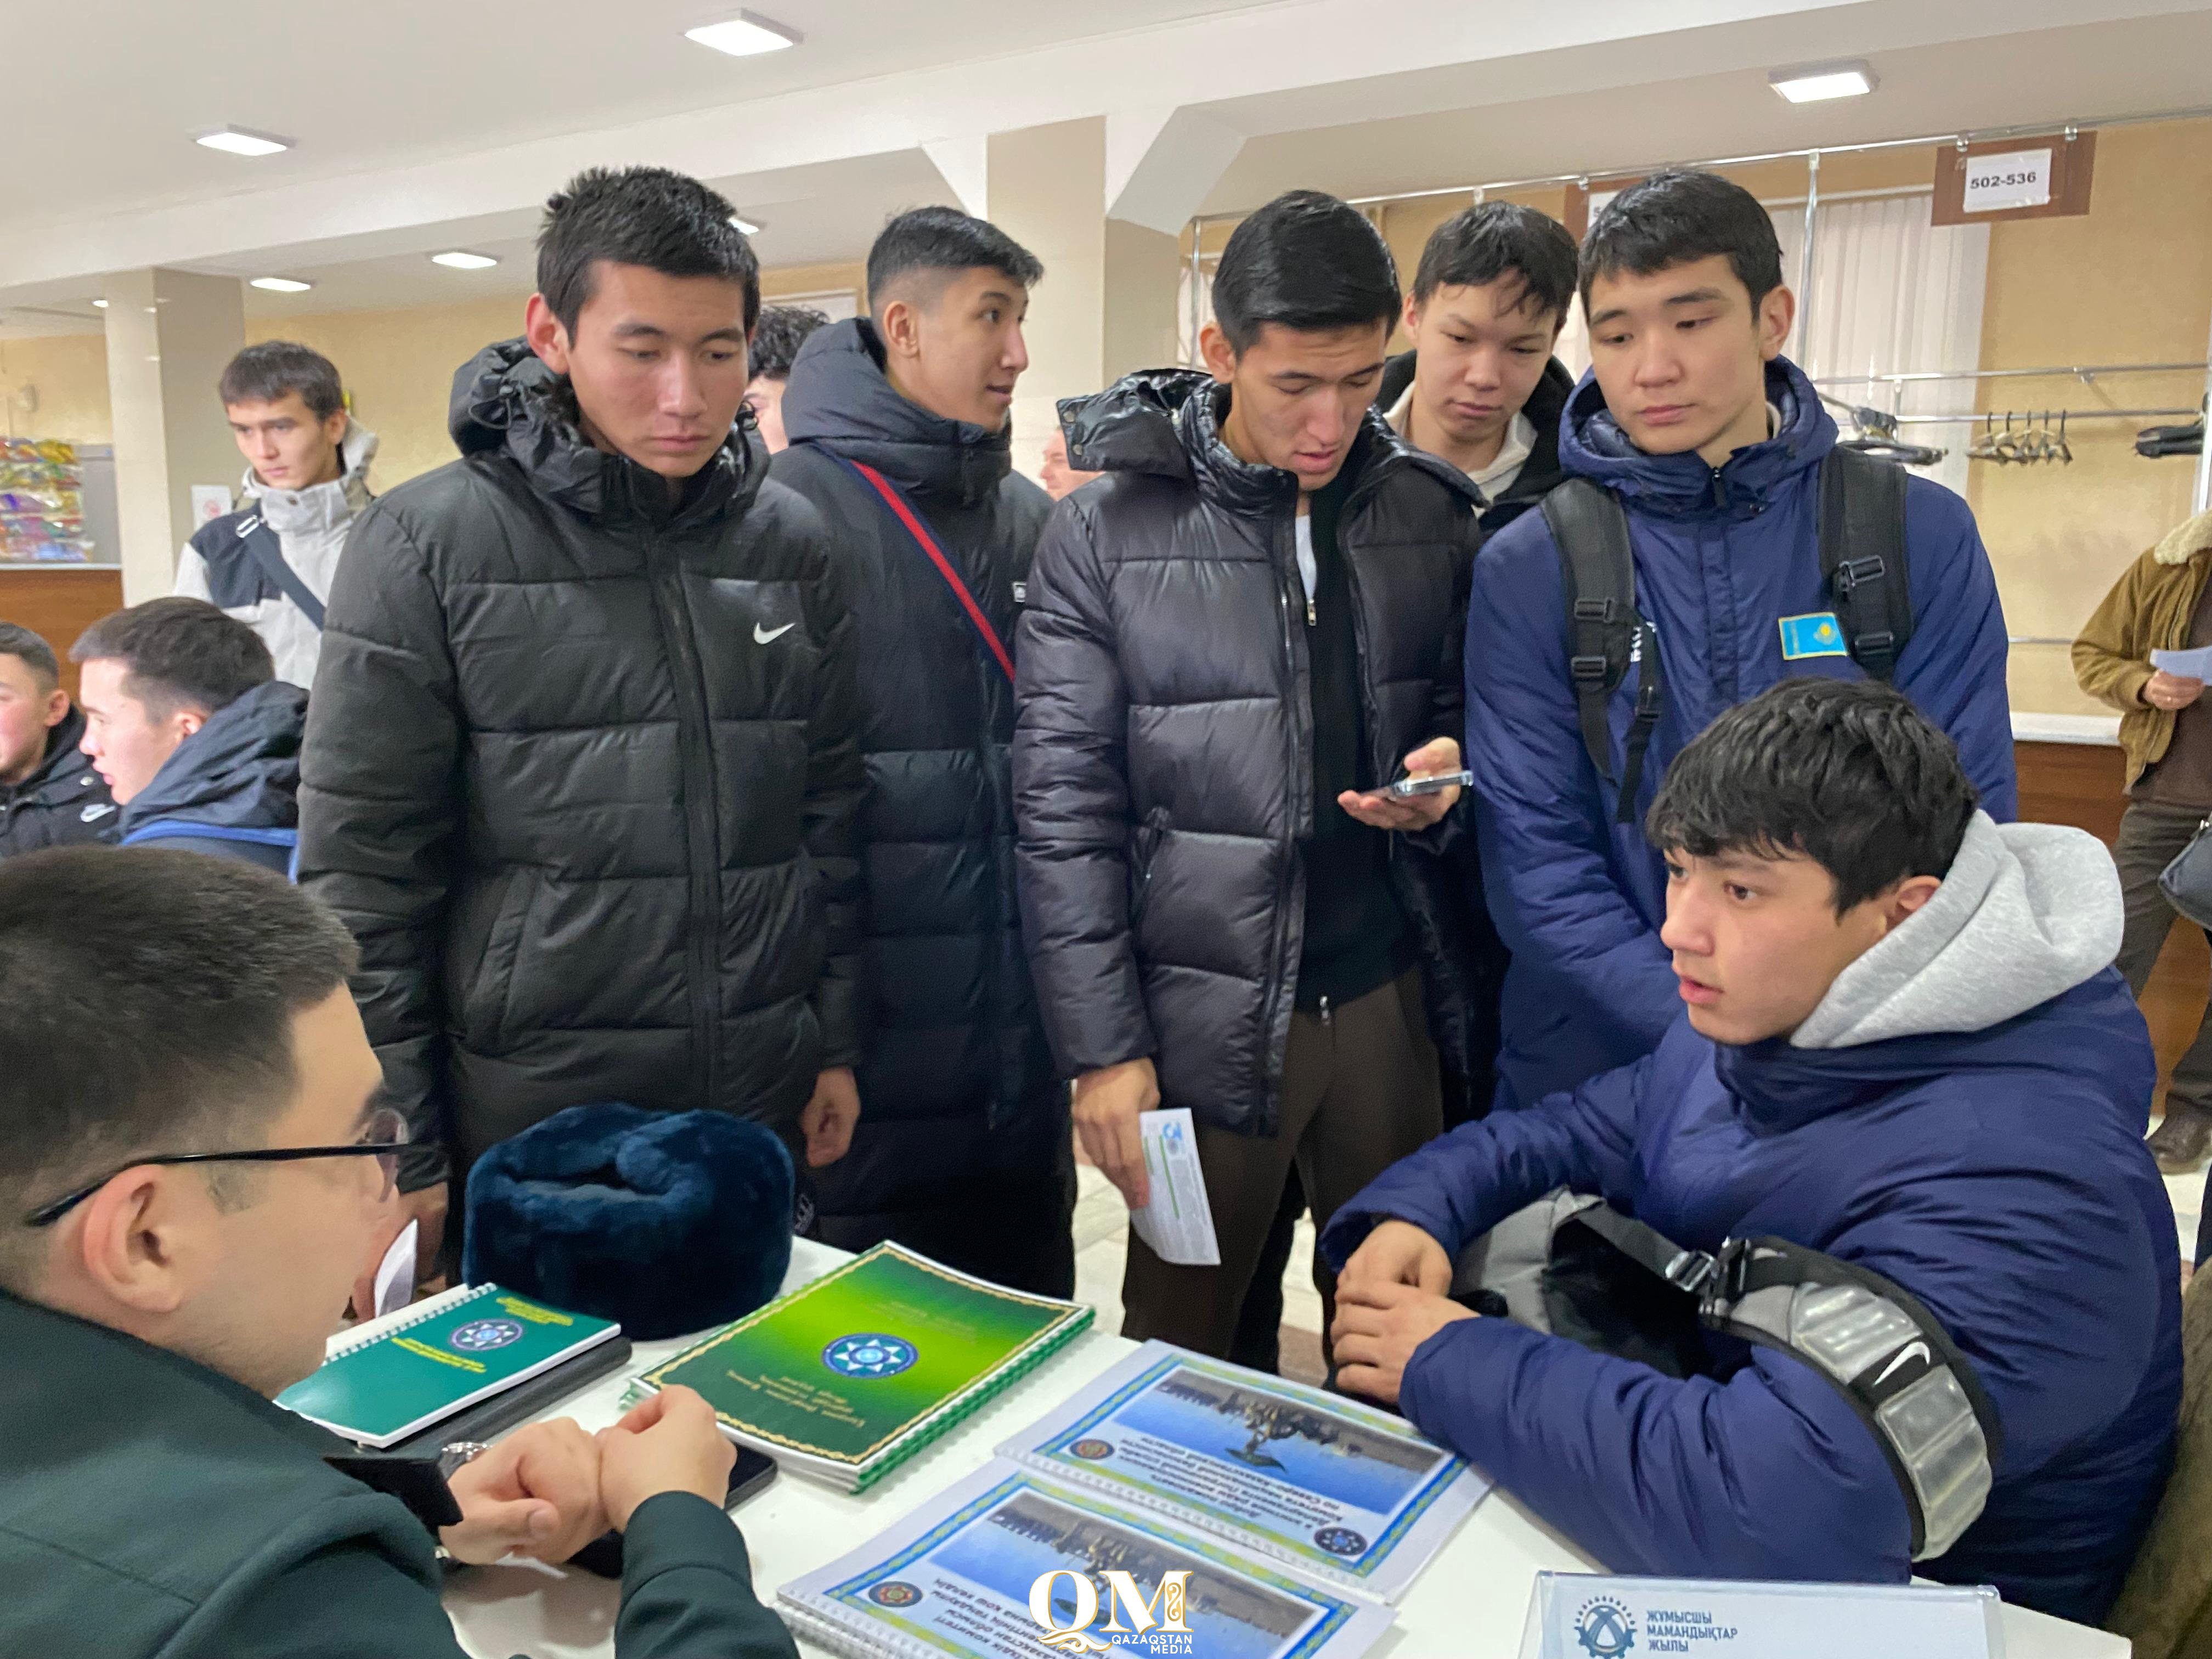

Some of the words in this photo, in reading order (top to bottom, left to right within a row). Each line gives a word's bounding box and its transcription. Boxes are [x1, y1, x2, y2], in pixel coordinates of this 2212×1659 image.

[1970, 171, 2036, 189] 502-536
[1647, 1624, 1738, 1641] МАМАНДЫҚТАР
[1649, 1639, 1689, 1652] ЖЫЛЫ
